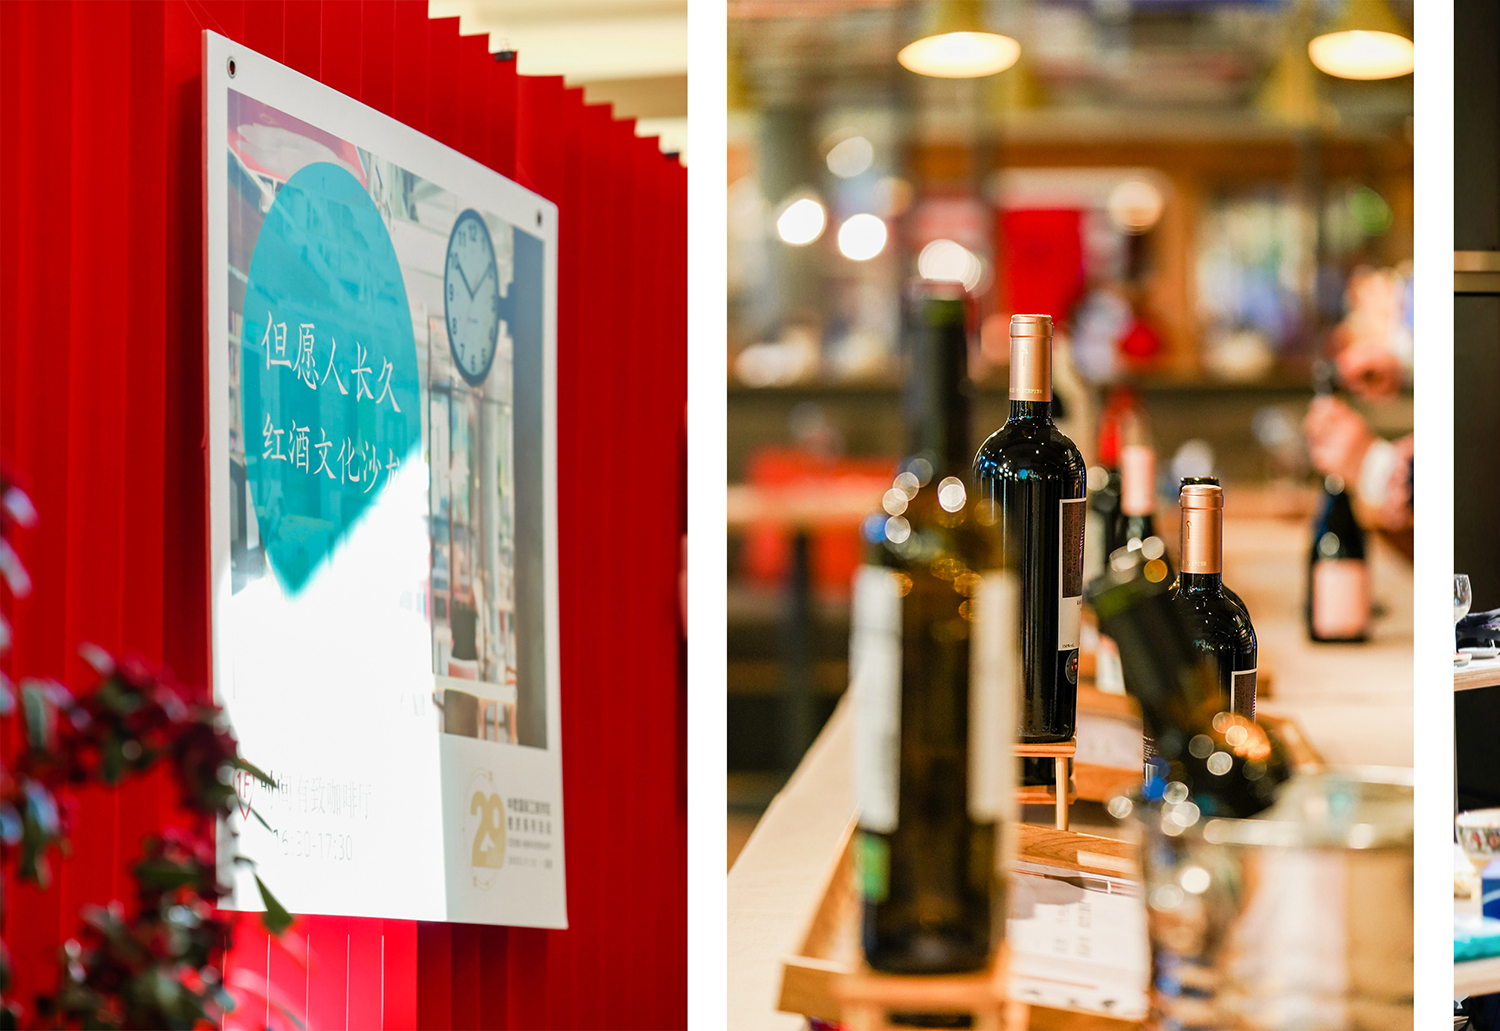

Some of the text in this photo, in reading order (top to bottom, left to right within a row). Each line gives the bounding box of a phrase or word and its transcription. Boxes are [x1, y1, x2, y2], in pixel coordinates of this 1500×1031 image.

[457, 230, 467, 248] 11
[468, 224, 477, 243] 12
[261, 310, 401, 413] 但愿人长久
[470, 790, 506, 870] 29
